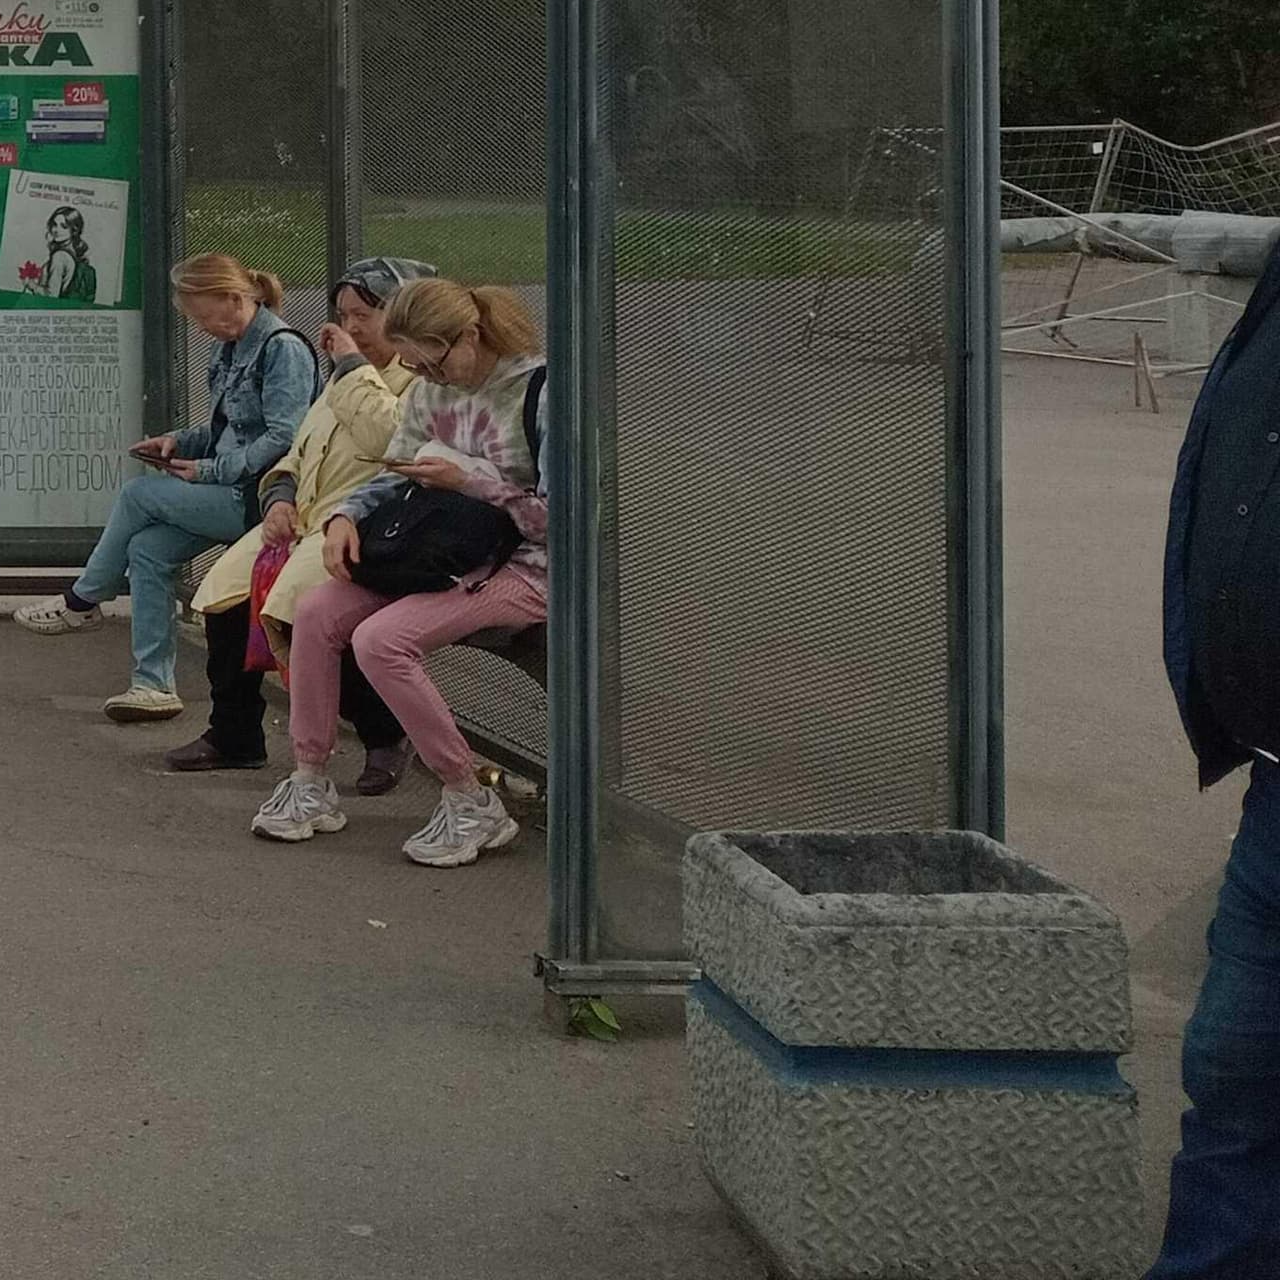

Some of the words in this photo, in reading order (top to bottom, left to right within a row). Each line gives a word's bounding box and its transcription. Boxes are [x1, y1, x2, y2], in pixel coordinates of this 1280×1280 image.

[1, 32, 41, 44] аптек
[67, 87, 99, 103] -20%
[28, 364, 121, 390] НЕОБХОДИМО
[21, 390, 122, 415] СПЕЦИАЛИСТА
